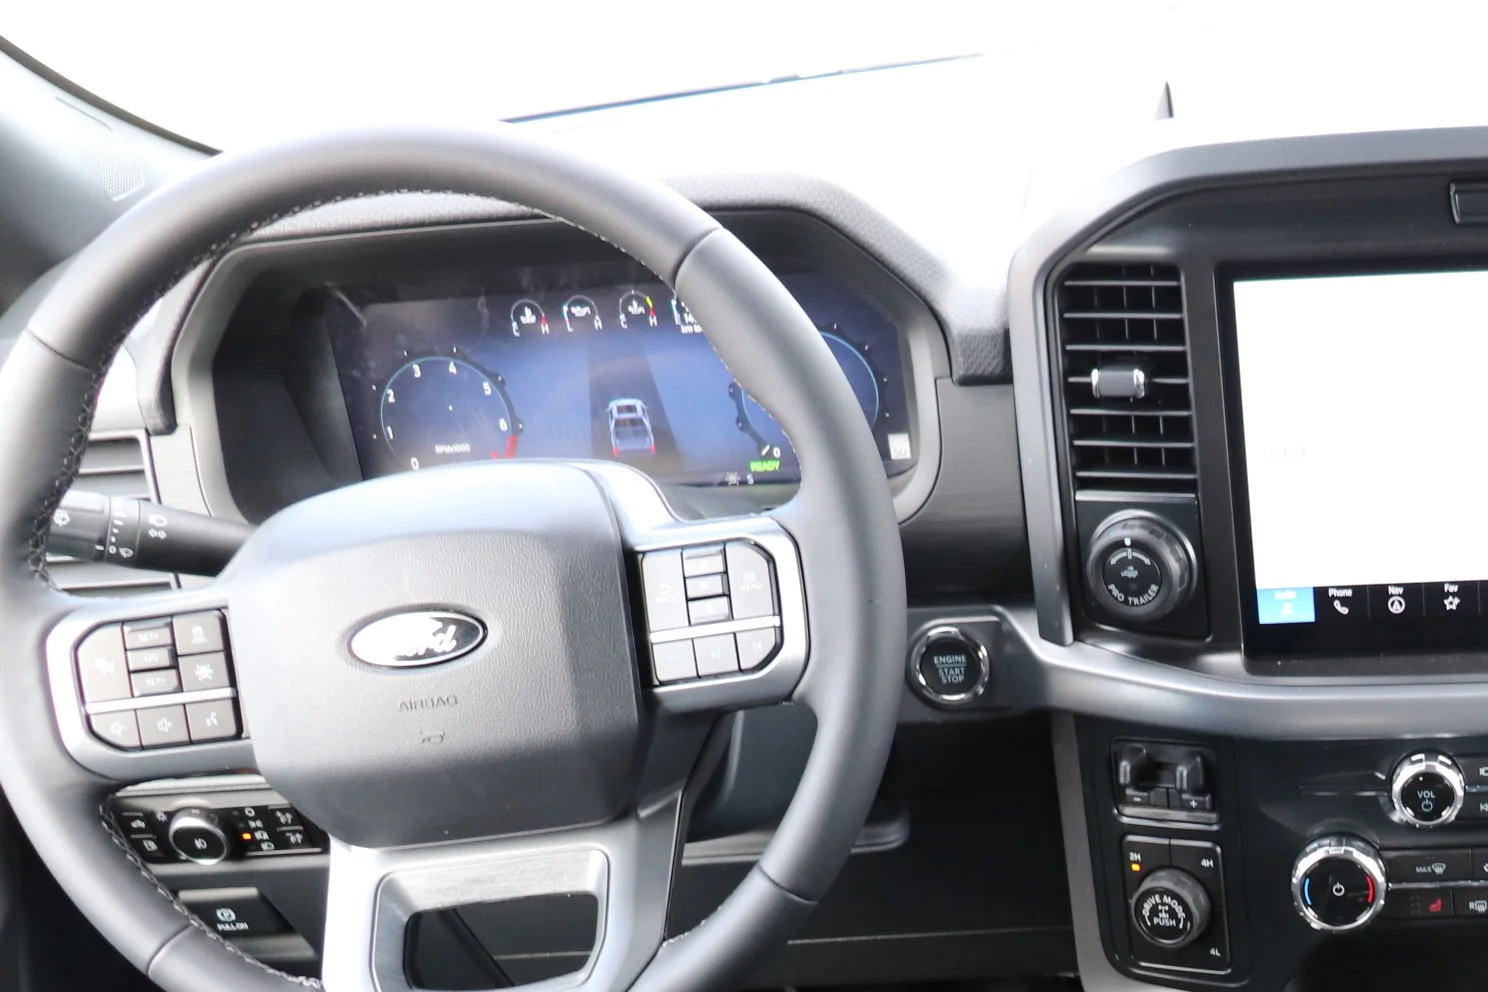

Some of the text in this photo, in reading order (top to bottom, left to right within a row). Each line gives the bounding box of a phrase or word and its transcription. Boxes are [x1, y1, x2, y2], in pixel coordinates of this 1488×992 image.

[412, 364, 421, 378] 3
[449, 361, 457, 375] 4
[482, 382, 491, 396] 5
[387, 389, 395, 403] 2
[499, 418, 508, 432] 6
[387, 426, 394, 440] 1
[411, 457, 419, 470] 0
[750, 460, 780, 472] READY
[1328, 587, 1353, 598] Phone
[1388, 585, 1404, 595] Nav
[1444, 583, 1459, 593] Fav
[1108, 583, 1159, 606] PRO TRAILER
[933, 654, 967, 664] ENGINE
[939, 666, 965, 676] START
[942, 674, 965, 685] STOP
[1417, 790, 1436, 799] VOL
[1129, 852, 1141, 861] 2H
[1201, 857, 1214, 868] 4H
[1416, 865, 1432, 874] MAX
[1142, 894, 1186, 920] DRIVE MODE
[1153, 918, 1176, 927] PUSH
[1210, 948, 1221, 957] 4L
